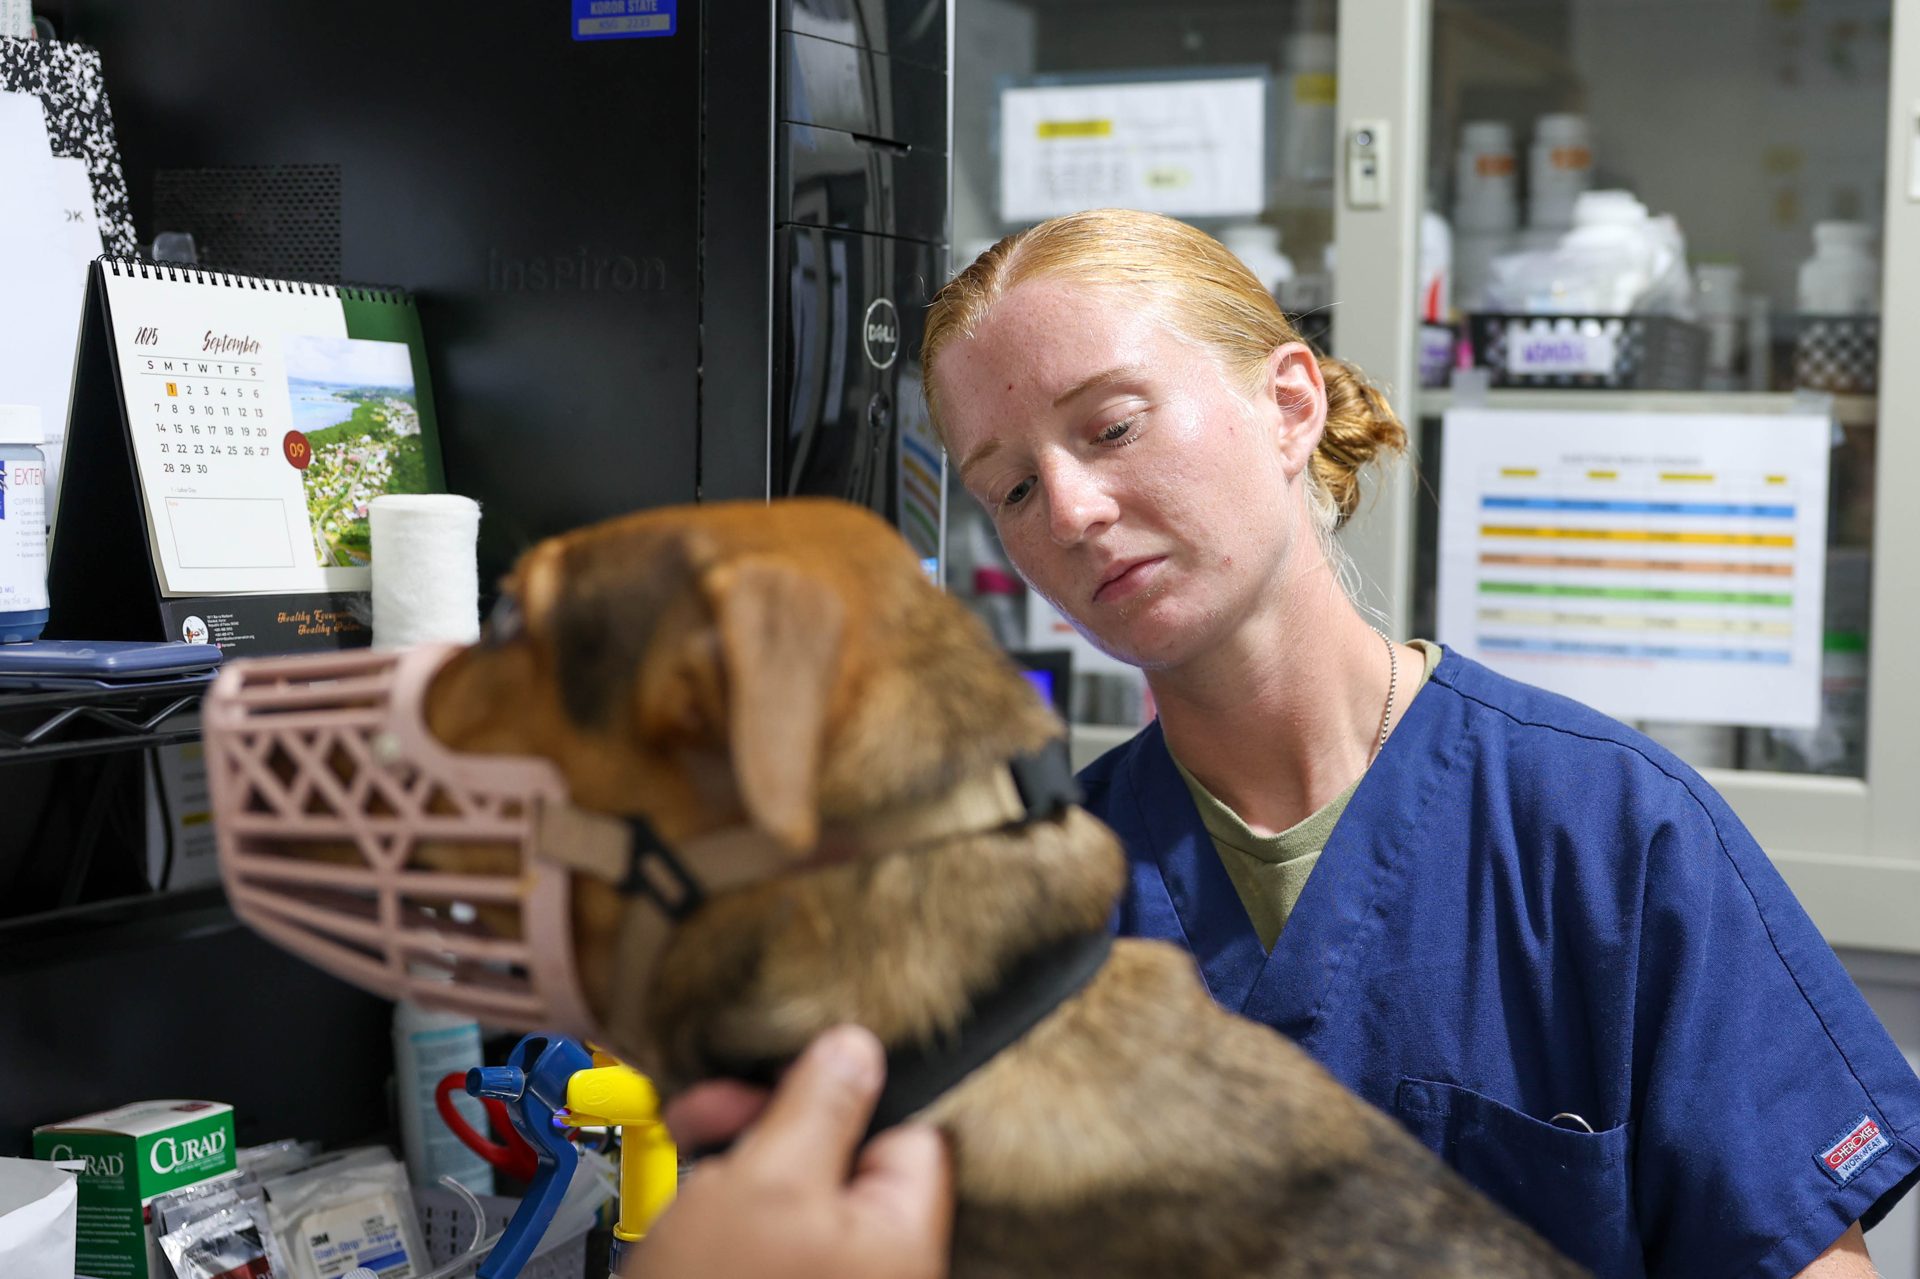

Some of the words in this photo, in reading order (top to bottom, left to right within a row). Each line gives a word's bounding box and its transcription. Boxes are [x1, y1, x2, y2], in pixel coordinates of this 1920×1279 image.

[627, 0, 658, 13] STATE
[868, 323, 896, 342] DELL
[134, 327, 159, 346] 2025
[203, 330, 261, 355] September
[147, 360, 154, 370] S
[164, 361, 173, 371] M
[183, 362, 189, 372] T
[198, 364, 208, 373] W
[217, 365, 223, 374] T
[234, 366, 240, 375] F
[250, 367, 257, 377] S
[168, 384, 174, 394] 1
[186, 385, 192, 395] 2
[203, 386, 210, 396] 3
[220, 387, 227, 396] 4
[237, 388, 243, 398] 5
[253, 389, 260, 399] 6
[154, 403, 160, 413] 7
[171, 404, 178, 414] 8
[188, 405, 195, 415] 9
[204, 406, 214, 416] 10
[222, 406, 230, 416] 11
[238, 407, 248, 417] 12
[254, 408, 264, 418] 13
[156, 423, 167, 433] 14
[173, 424, 183, 434] 15
[190, 425, 200, 435] 16
[207, 425, 216, 435] 17
[224, 426, 234, 436] 18
[241, 427, 250, 437] 19
[257, 428, 267, 437] 20
[160, 443, 170, 453] 21
[176, 444, 187, 454] 22
[193, 445, 204, 454] 23
[210, 445, 221, 455] 24
[227, 446, 238, 456] 25
[243, 446, 254, 456] 26
[260, 447, 270, 457] 27
[289, 443, 304, 458] 09
[163, 463, 175, 473] 28
[180, 464, 191, 474] 29
[196, 464, 208, 474] 30
[277, 610, 311, 624] Healthy
[298, 622, 330, 636] Healthy
[150, 1129, 226, 1175] CURAD
[1829, 1125, 1877, 1165] CHEROKEE
[311, 1231, 329, 1247] 3M
